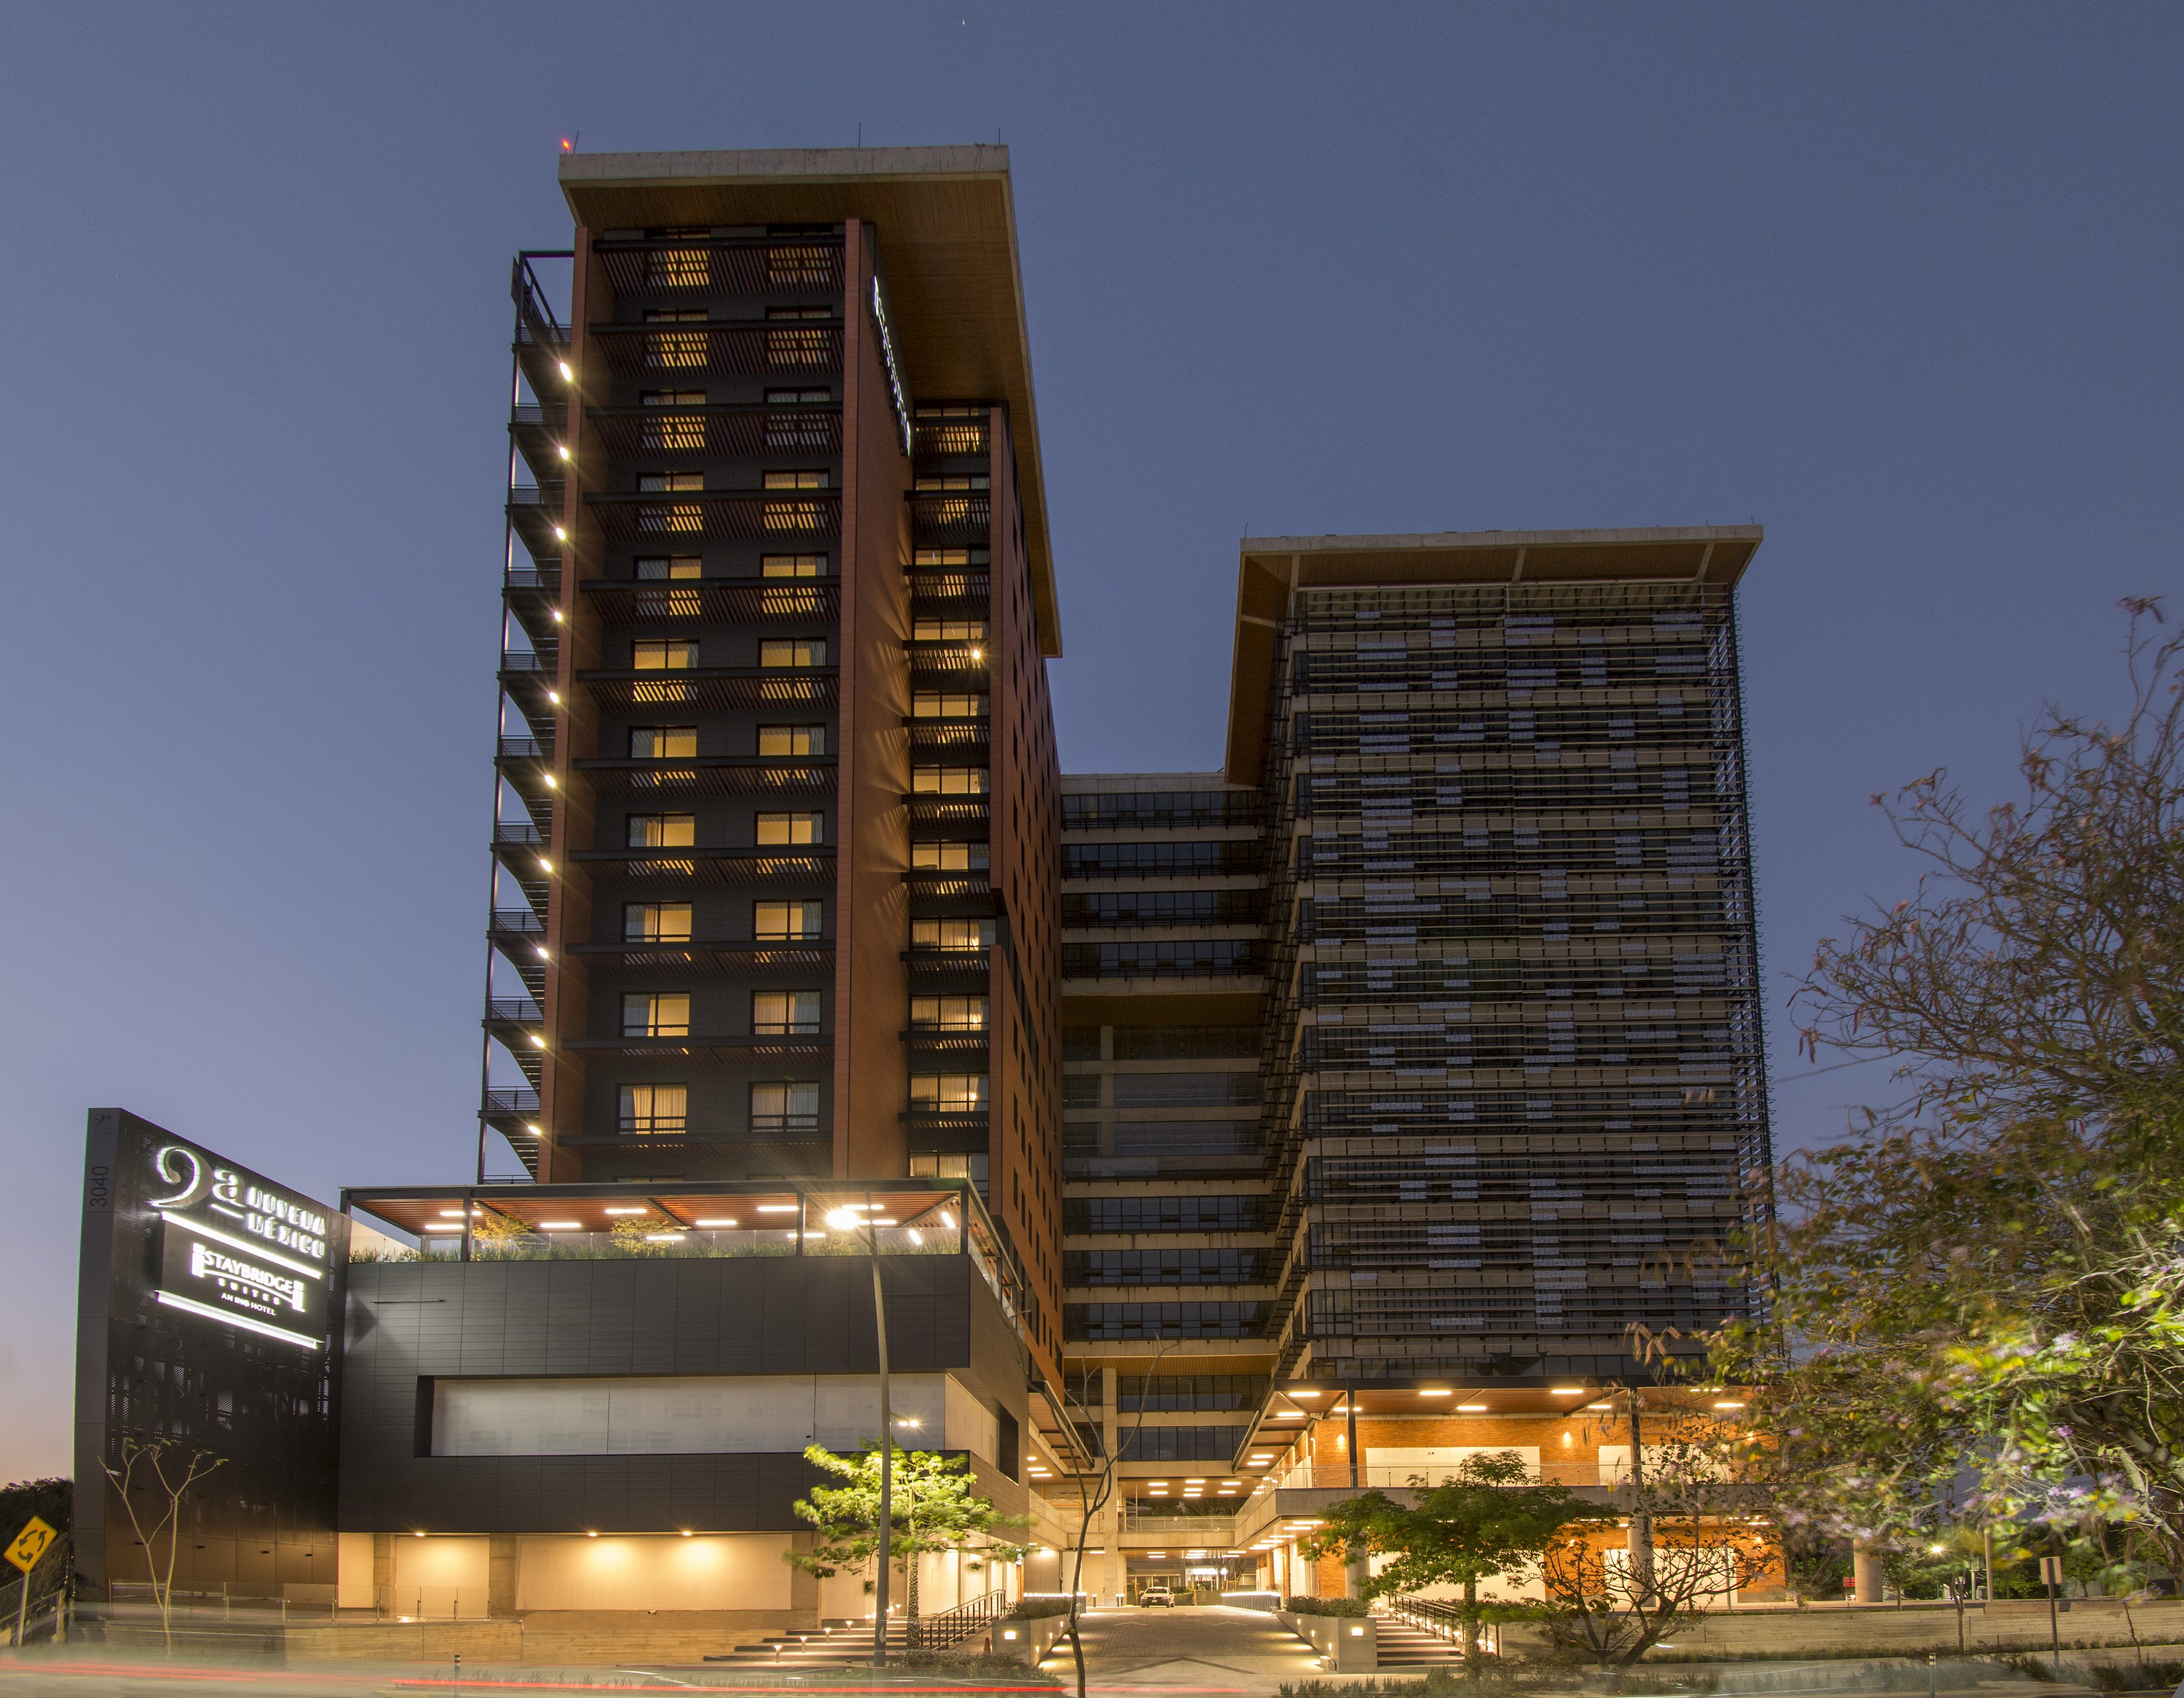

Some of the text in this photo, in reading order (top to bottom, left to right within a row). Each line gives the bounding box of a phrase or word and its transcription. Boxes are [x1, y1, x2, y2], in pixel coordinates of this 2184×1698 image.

[90, 1166, 109, 1207] 3040
[150, 1146, 246, 1207] 9a
[204, 1250, 293, 1294] STAYBRIDGE
[217, 1278, 280, 1305] SUITES
[221, 1293, 233, 1301] AN
[251, 1302, 276, 1316] HOTEL
